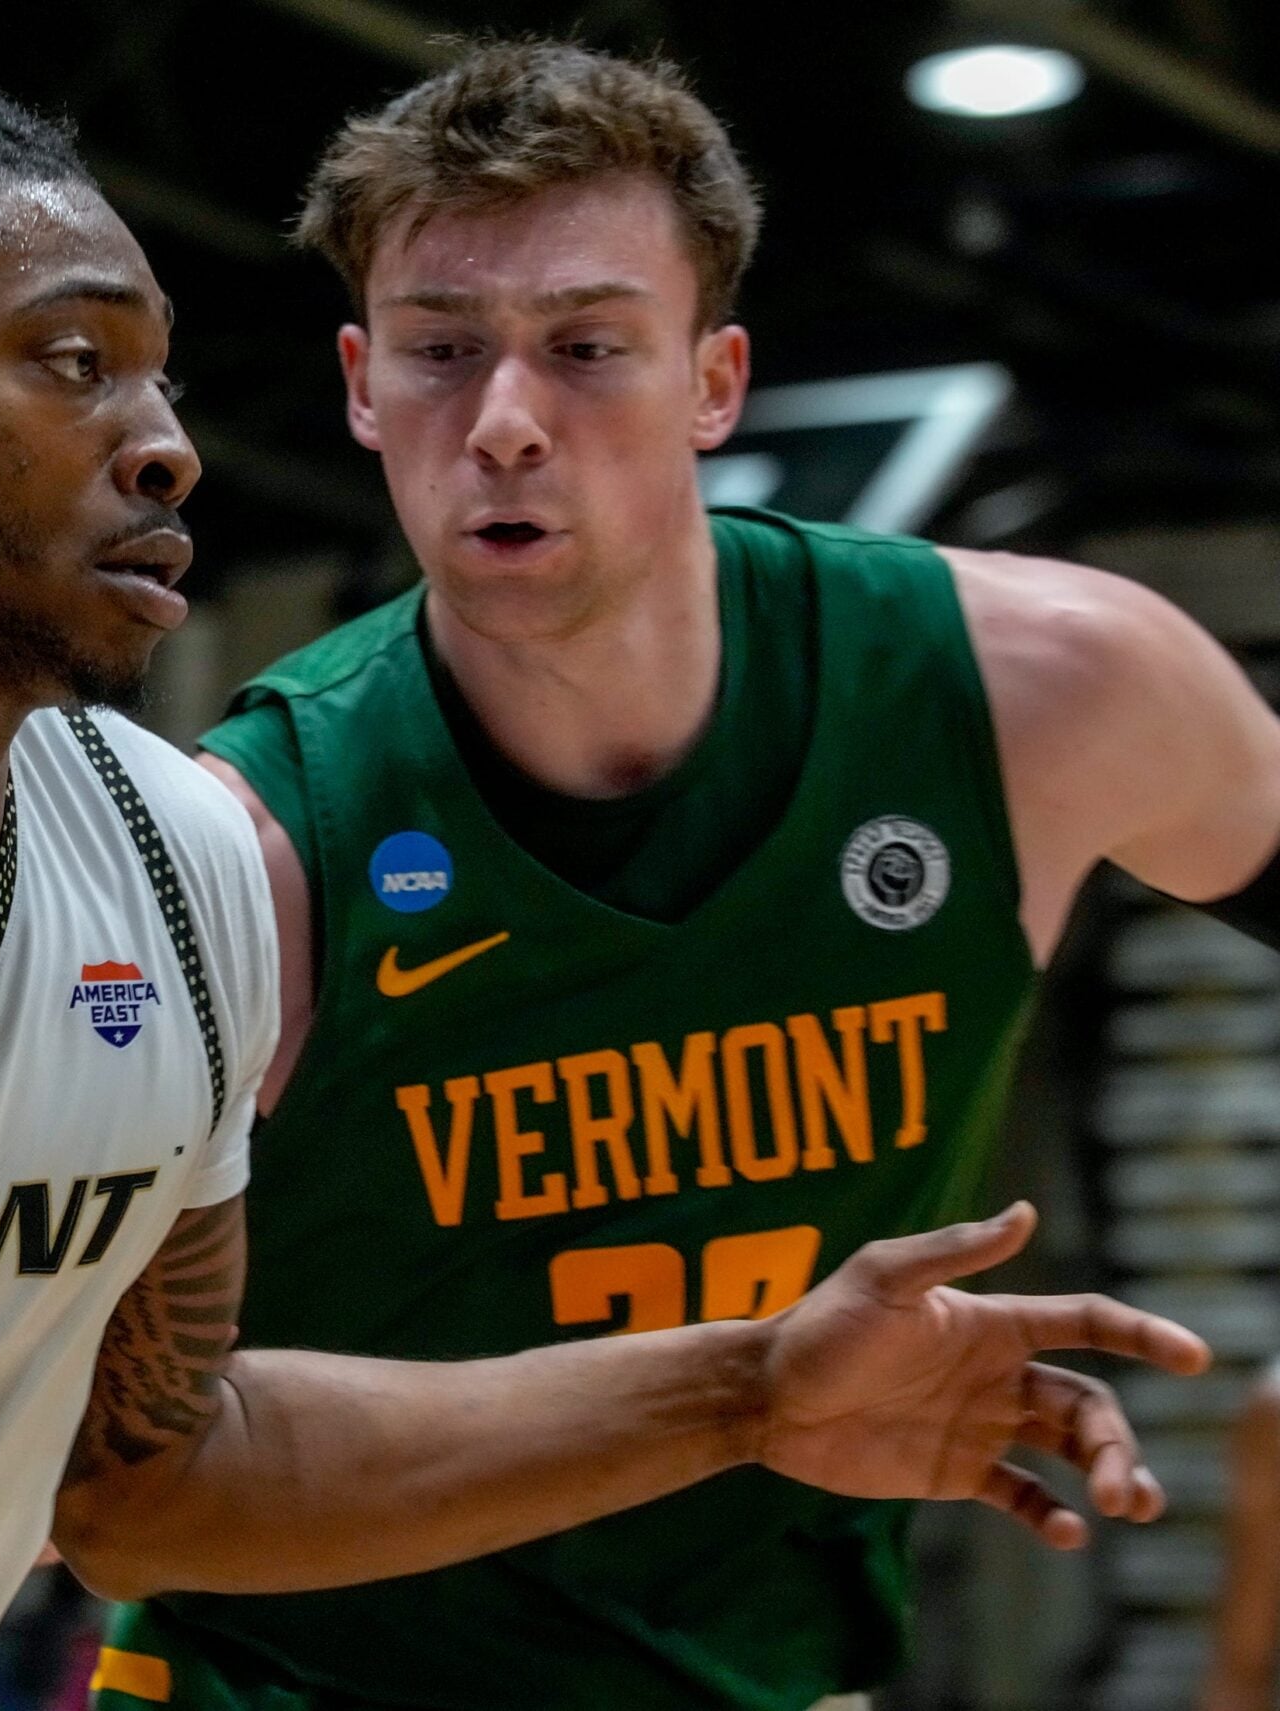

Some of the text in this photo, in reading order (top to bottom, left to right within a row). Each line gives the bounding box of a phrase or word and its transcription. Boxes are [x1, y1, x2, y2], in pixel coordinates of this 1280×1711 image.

[381, 871, 448, 893] NCAA
[68, 982, 162, 1009] AMERICA
[90, 1003, 141, 1024] EAST
[395, 991, 948, 1227] VERMONT
